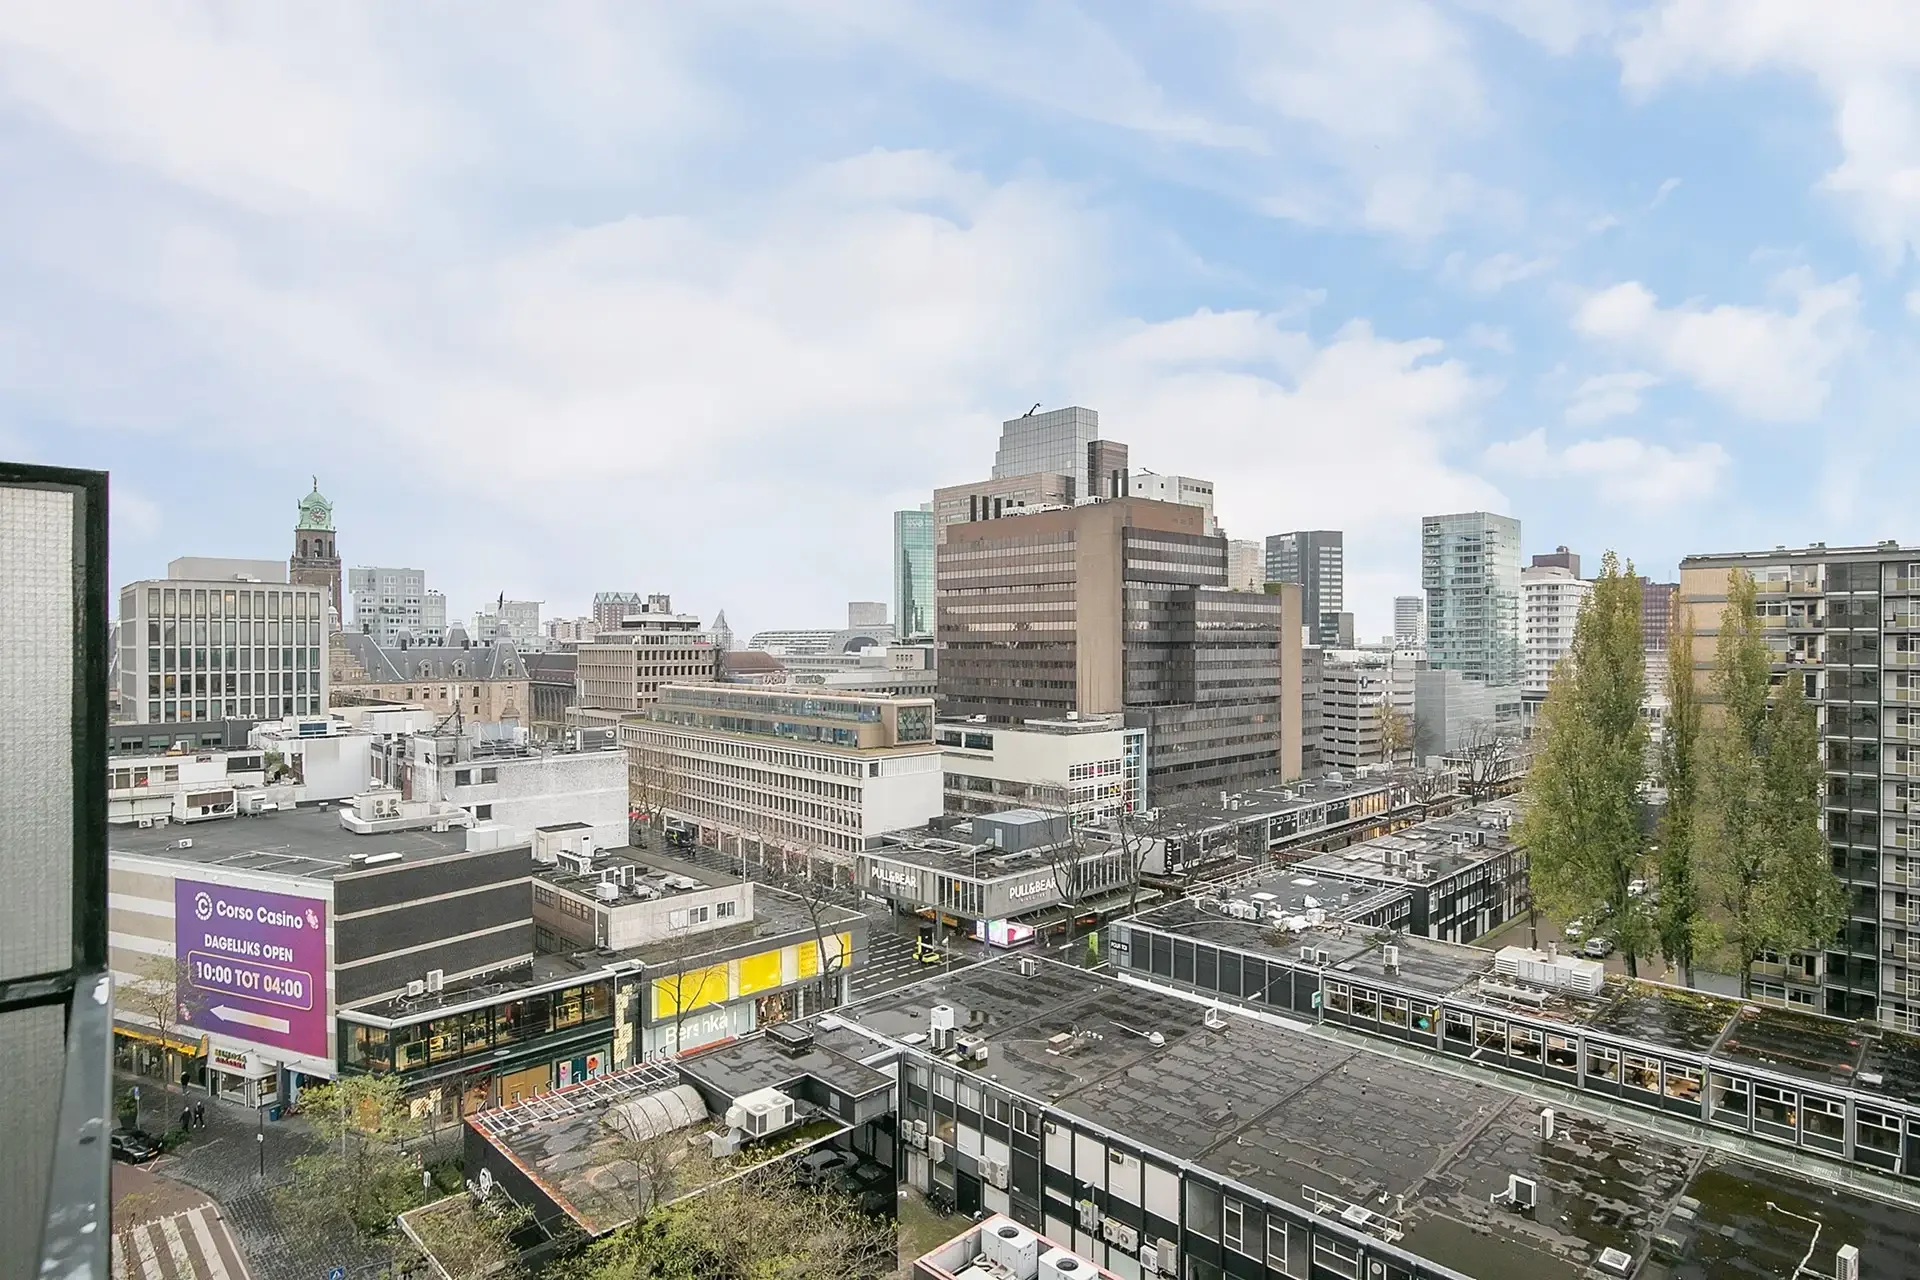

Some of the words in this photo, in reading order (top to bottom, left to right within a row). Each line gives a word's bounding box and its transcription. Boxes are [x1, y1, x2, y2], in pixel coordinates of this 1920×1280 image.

[871, 865, 917, 888] PULL&BEAR
[1009, 877, 1057, 899] PULL&BEAR
[216, 900, 253, 921] Corso
[256, 906, 303, 929] Casino
[204, 933, 261, 957] DAGELIJKS
[263, 944, 293, 962] OPEN
[196, 961, 232, 985] 10:00
[235, 969, 260, 990] TOT
[263, 975, 303, 998] 04:00
[665, 1014, 728, 1045] Bershka
